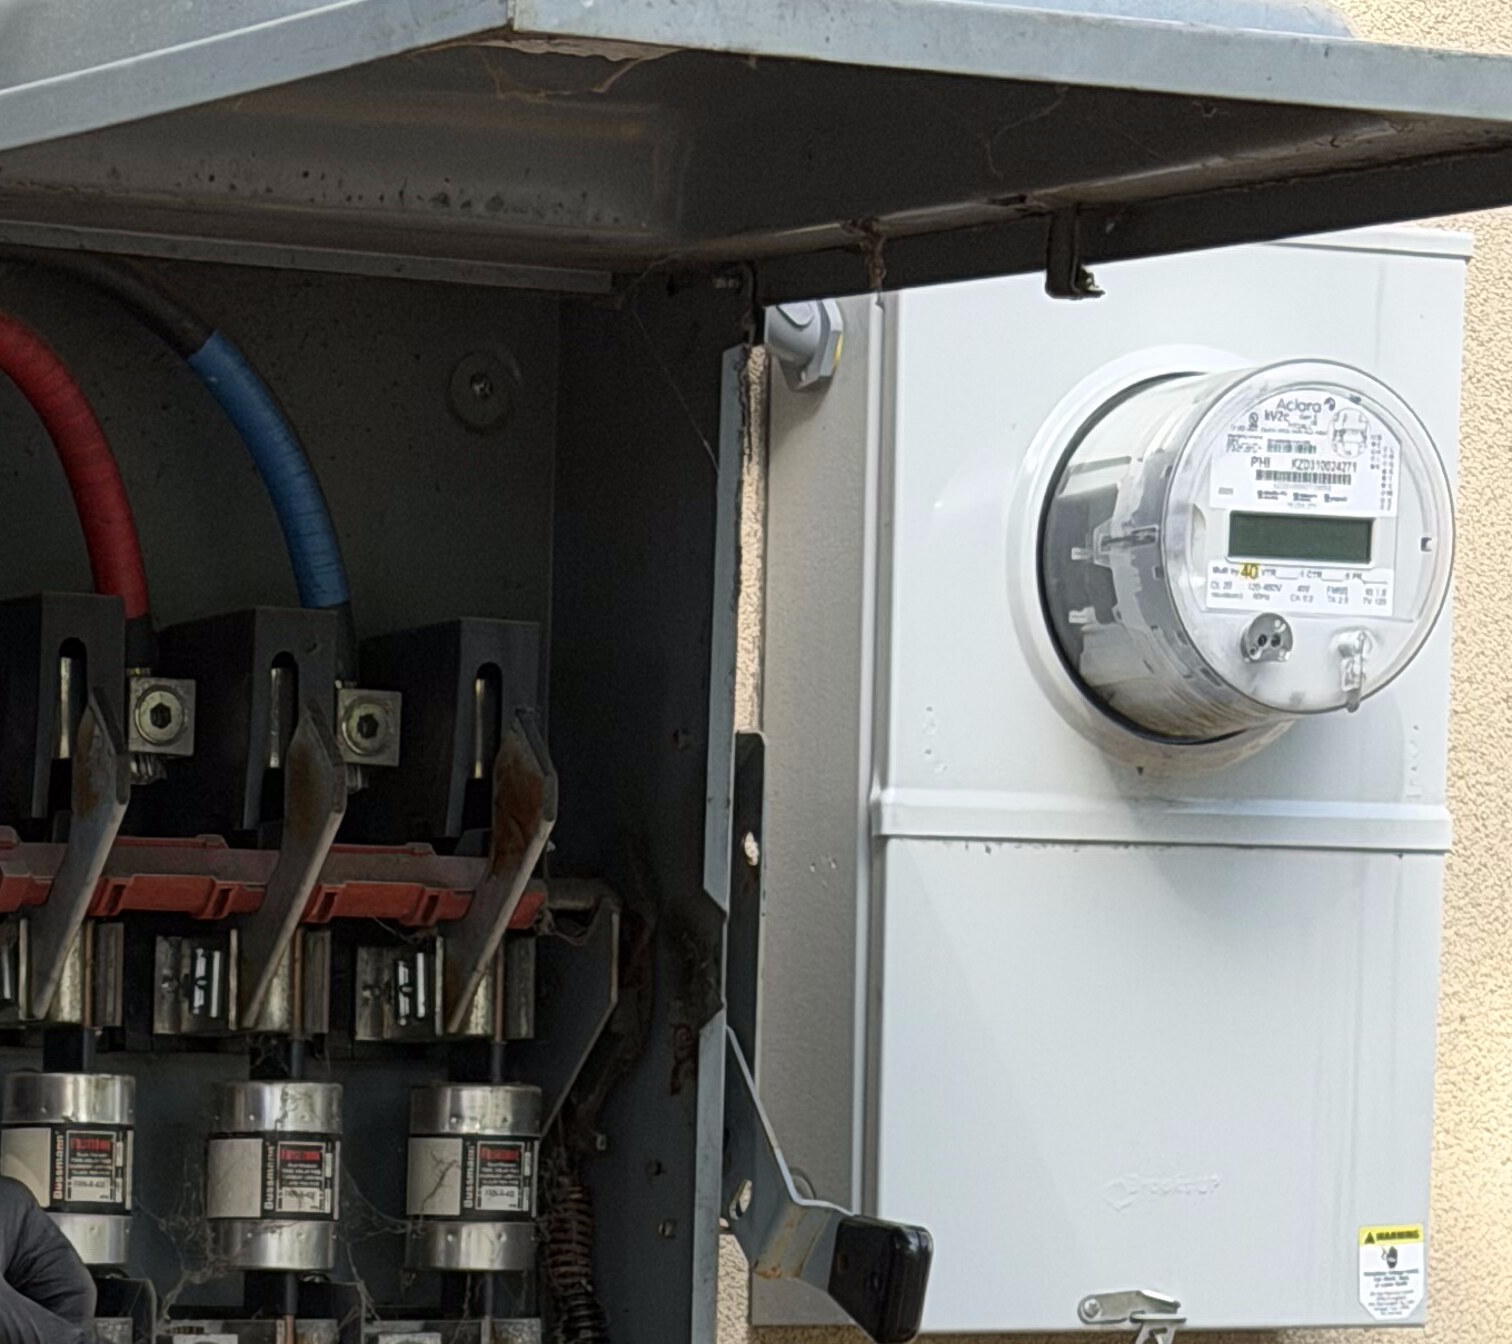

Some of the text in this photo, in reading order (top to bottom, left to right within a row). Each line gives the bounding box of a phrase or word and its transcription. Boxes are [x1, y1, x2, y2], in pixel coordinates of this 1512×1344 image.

[1276, 398, 1322, 413] Aclara
[1250, 456, 1271, 468] PHI
[1240, 563, 1259, 579] 40
